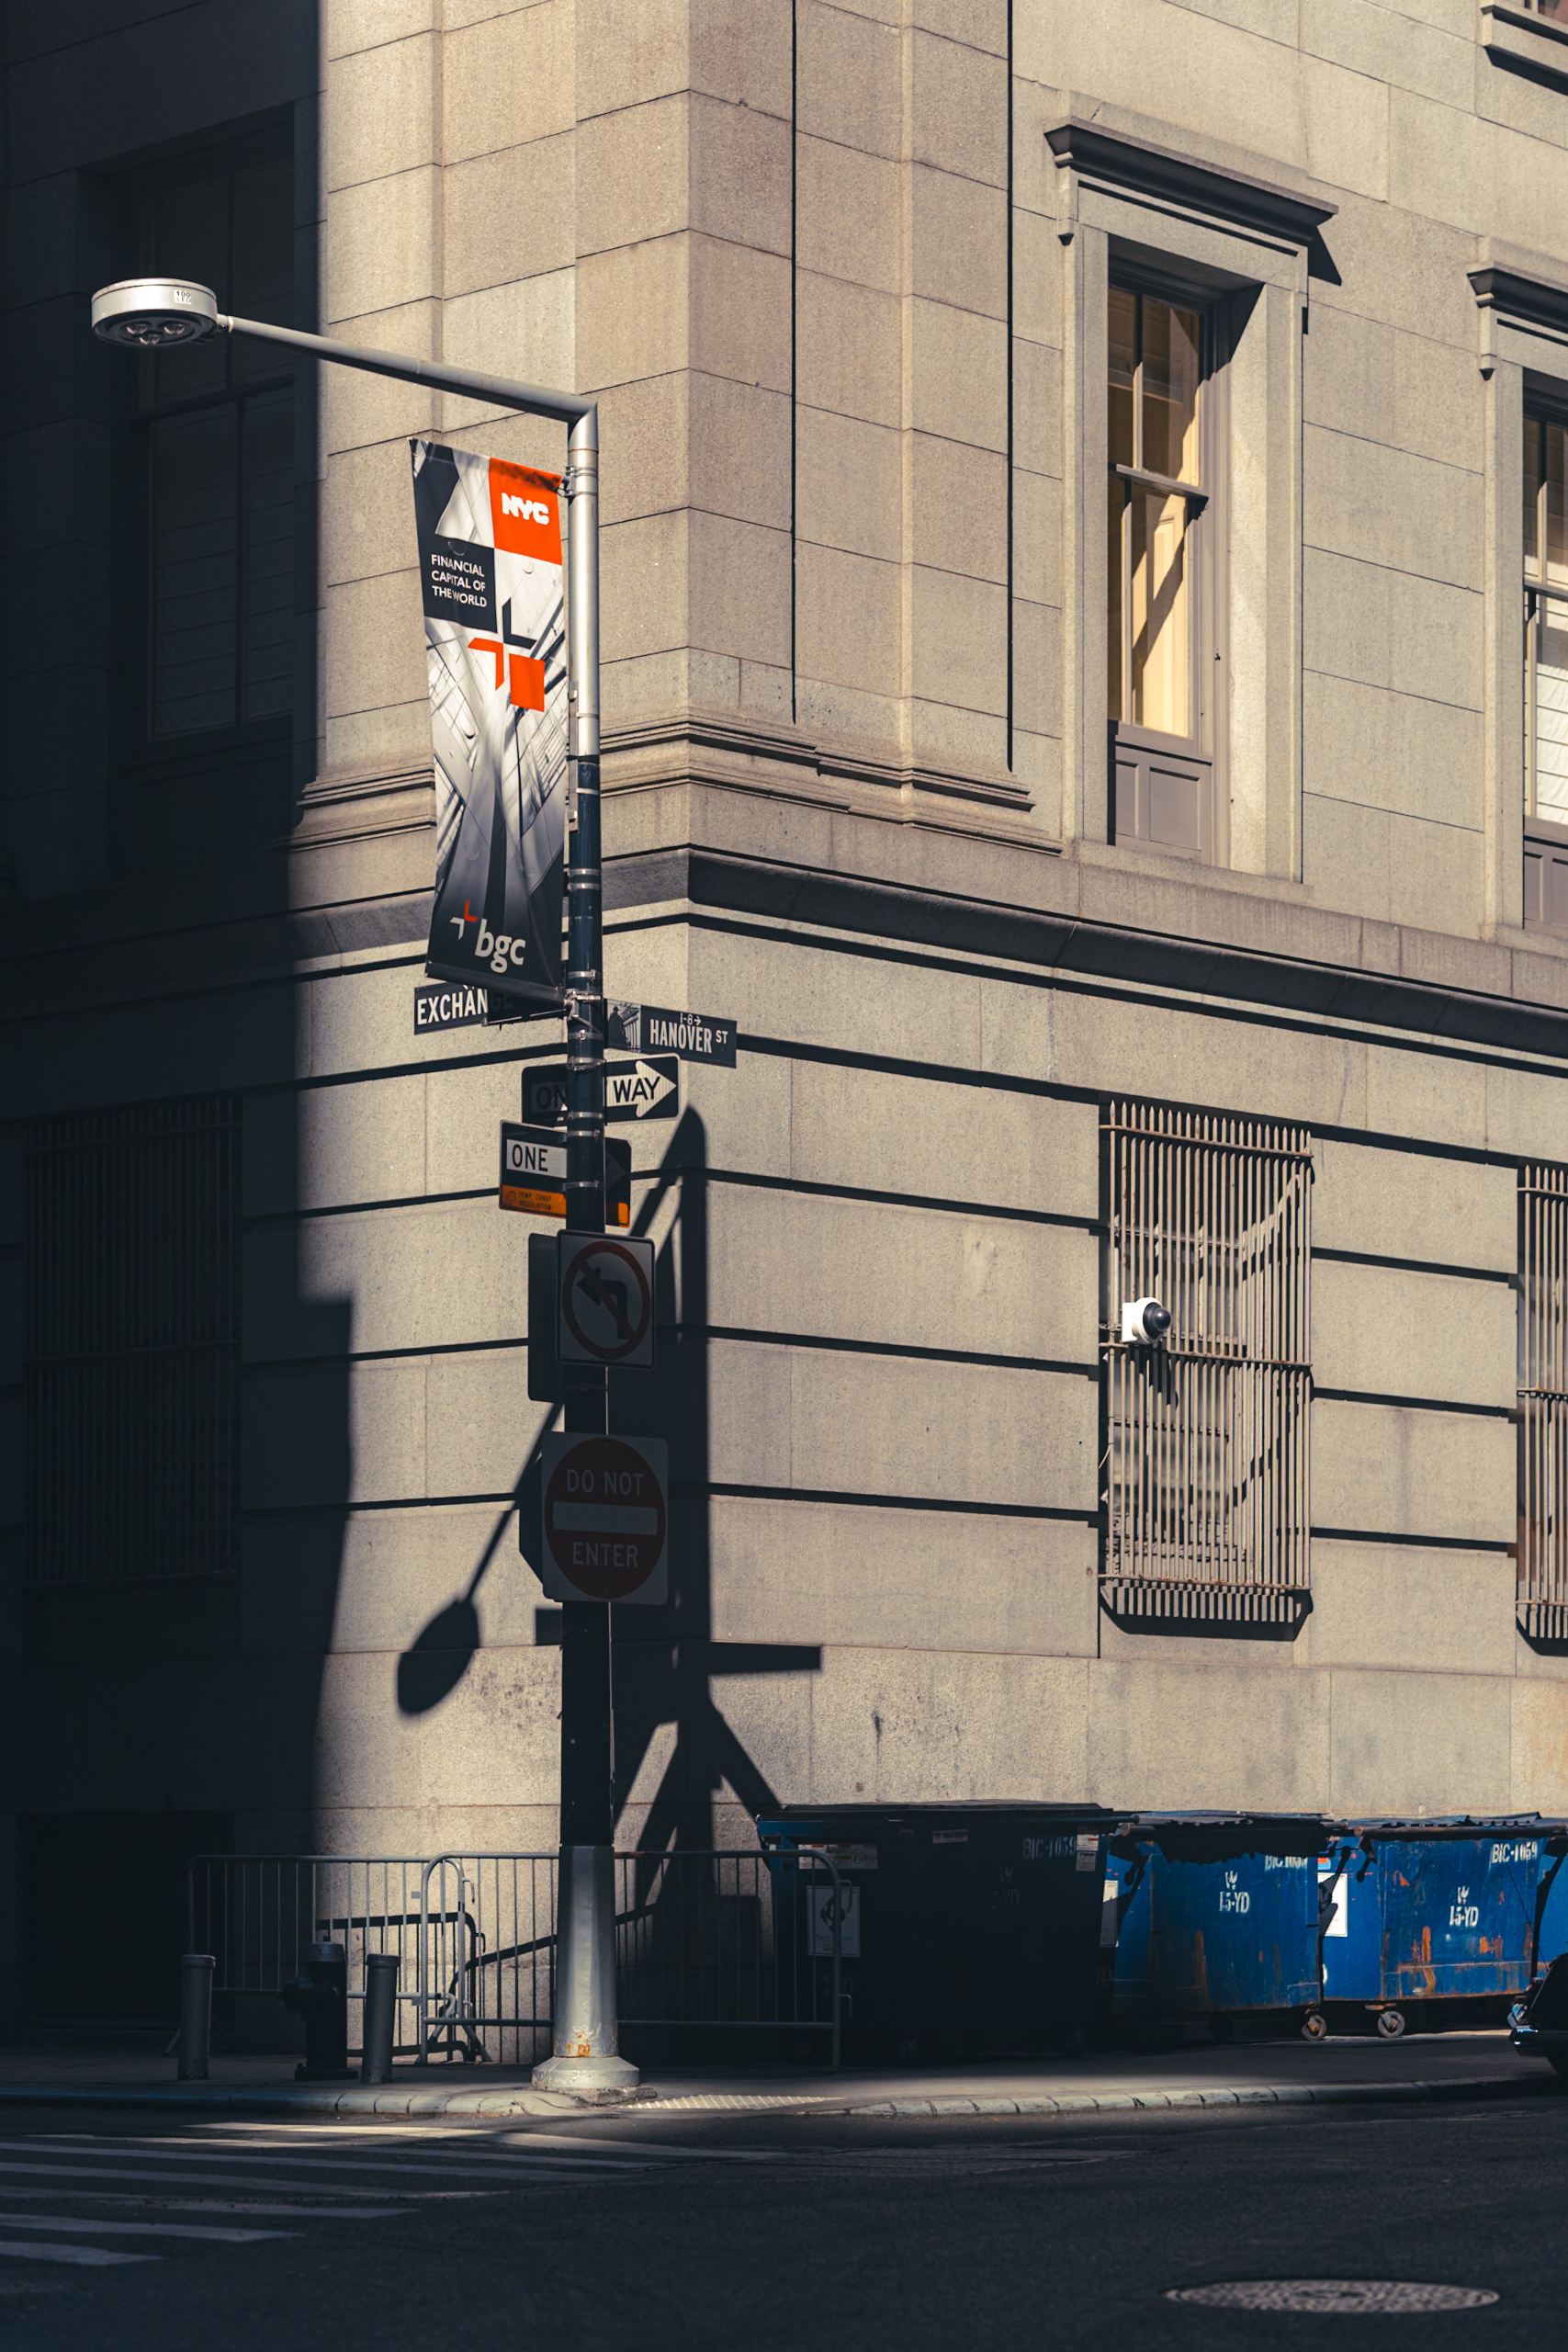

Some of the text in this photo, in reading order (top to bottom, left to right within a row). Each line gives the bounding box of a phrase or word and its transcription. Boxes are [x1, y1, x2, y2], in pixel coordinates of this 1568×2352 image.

[502, 492, 549, 526] NYC
[431, 554, 485, 577] FINANCIAL
[431, 571, 486, 592] CAPITAL OF
[432, 585, 487, 607] THE WORLD
[474, 918, 526, 973] bgc
[649, 1018, 728, 1054] HANOVER ST
[536, 1076, 660, 1110] ON WAY
[512, 1144, 548, 1172] ONE
[518, 1191, 533, 1200] TEMP
[567, 1468, 644, 1497] DO NOT
[572, 1542, 638, 1568] ENTER
